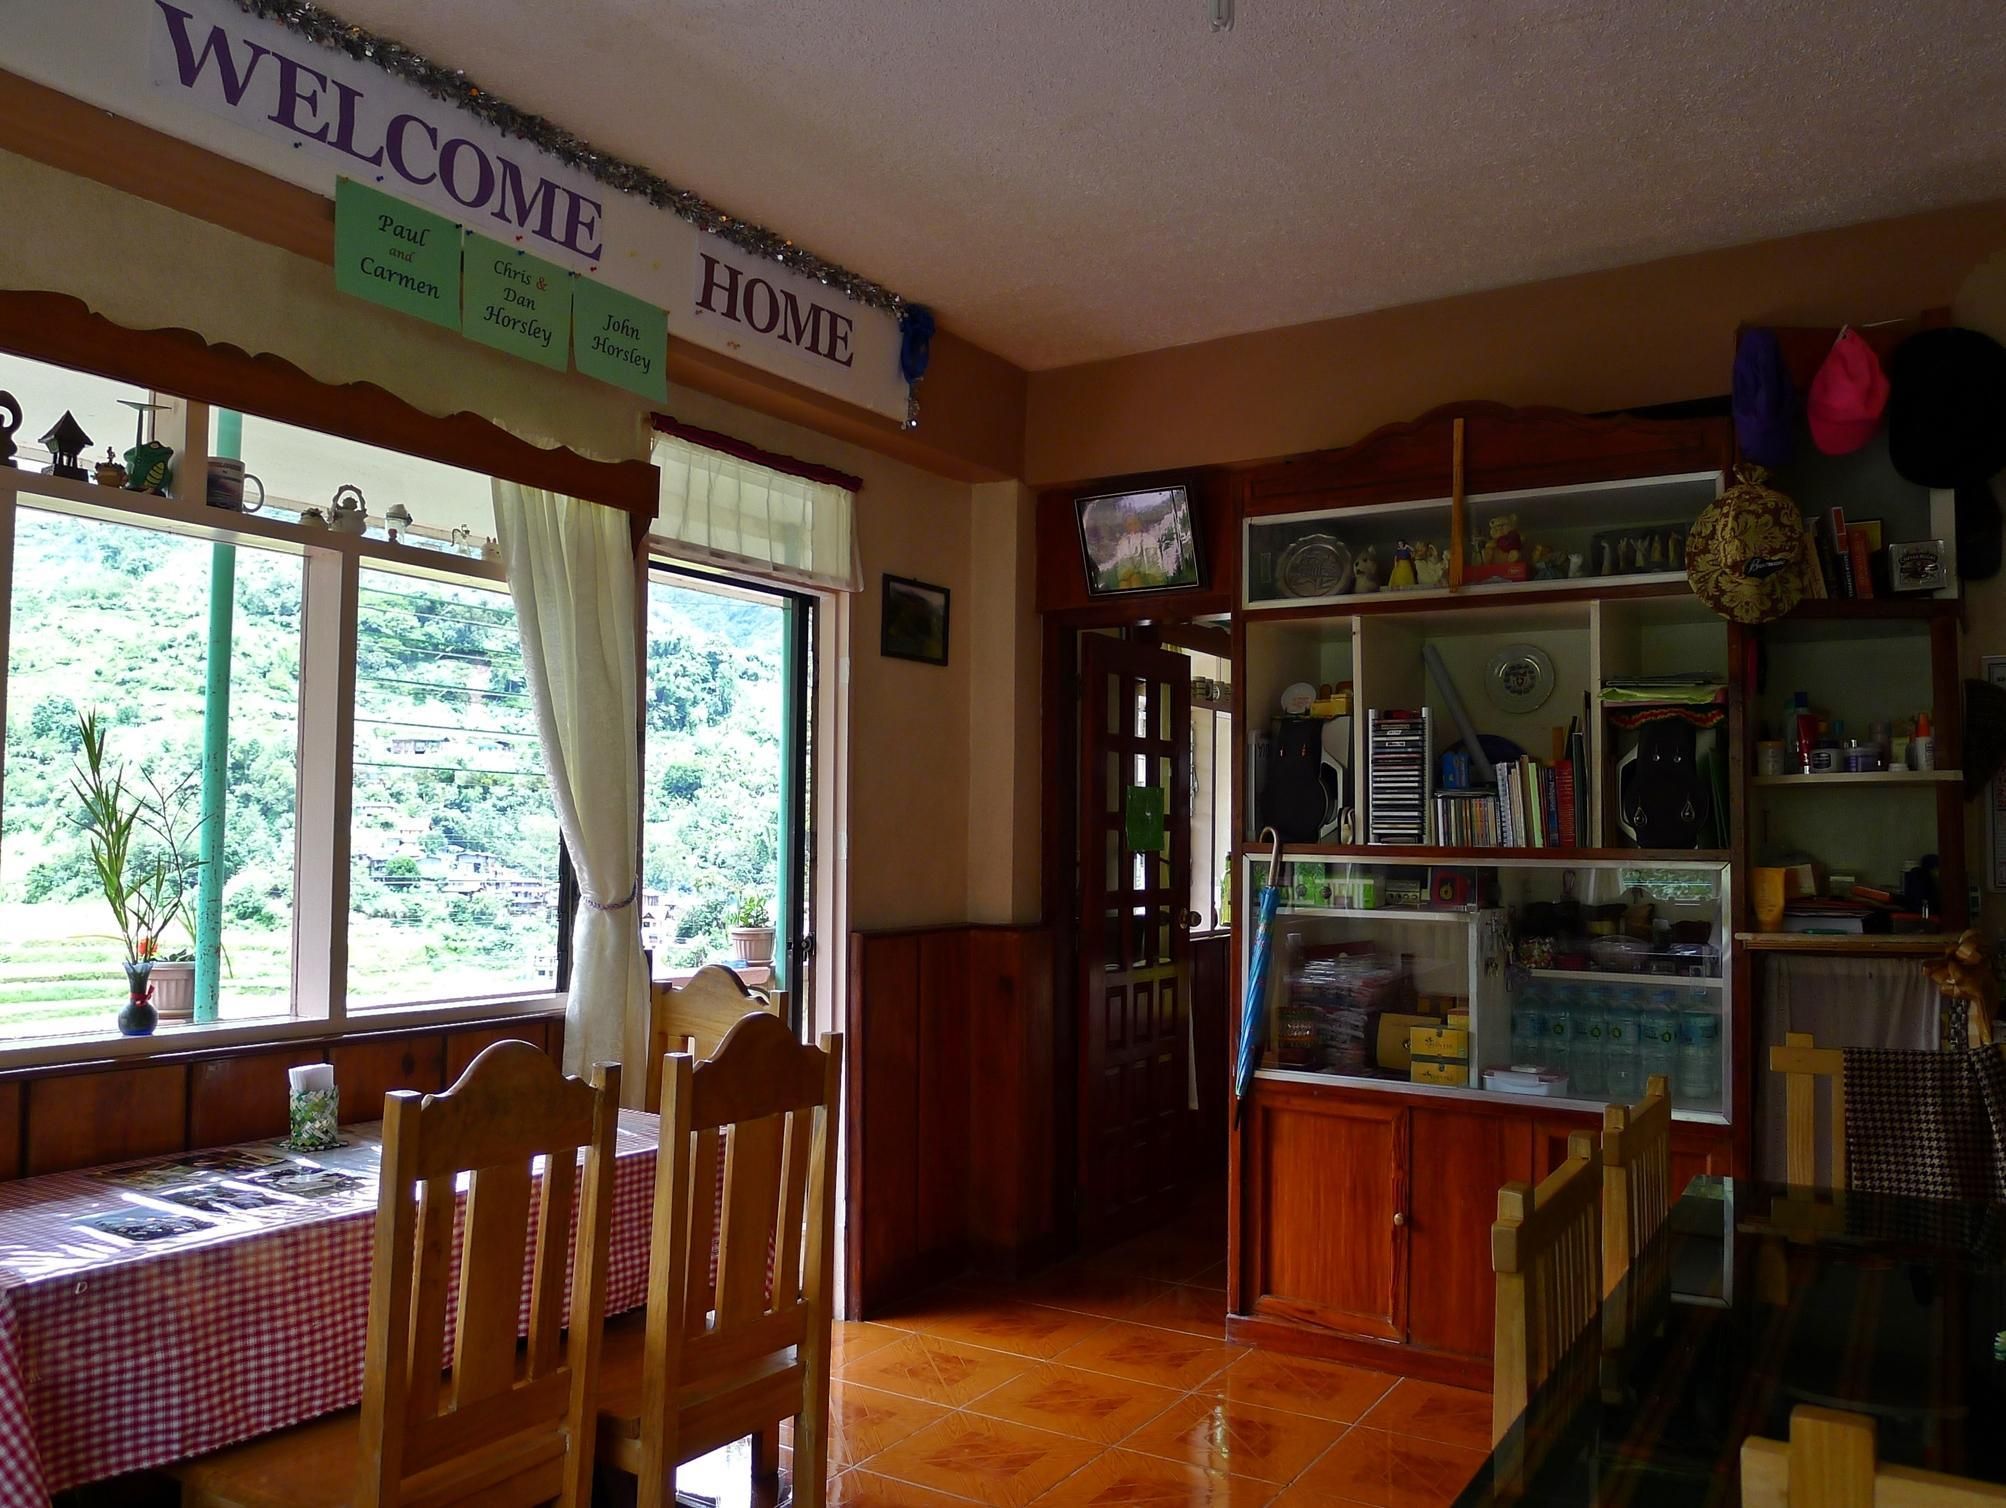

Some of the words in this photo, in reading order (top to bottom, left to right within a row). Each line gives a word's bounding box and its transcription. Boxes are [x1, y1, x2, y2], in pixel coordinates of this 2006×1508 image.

[155, 0, 603, 261] WELCOME
[695, 252, 854, 368] HOME
[378, 214, 431, 248] Paul
[389, 245, 416, 264] and
[360, 256, 440, 300] Carmen
[493, 259, 533, 287] Chris
[536, 276, 548, 292] &
[503, 287, 536, 311] Dan
[483, 304, 553, 348] Horsley
[602, 313, 642, 341] John
[591, 335, 651, 374] Horsley
